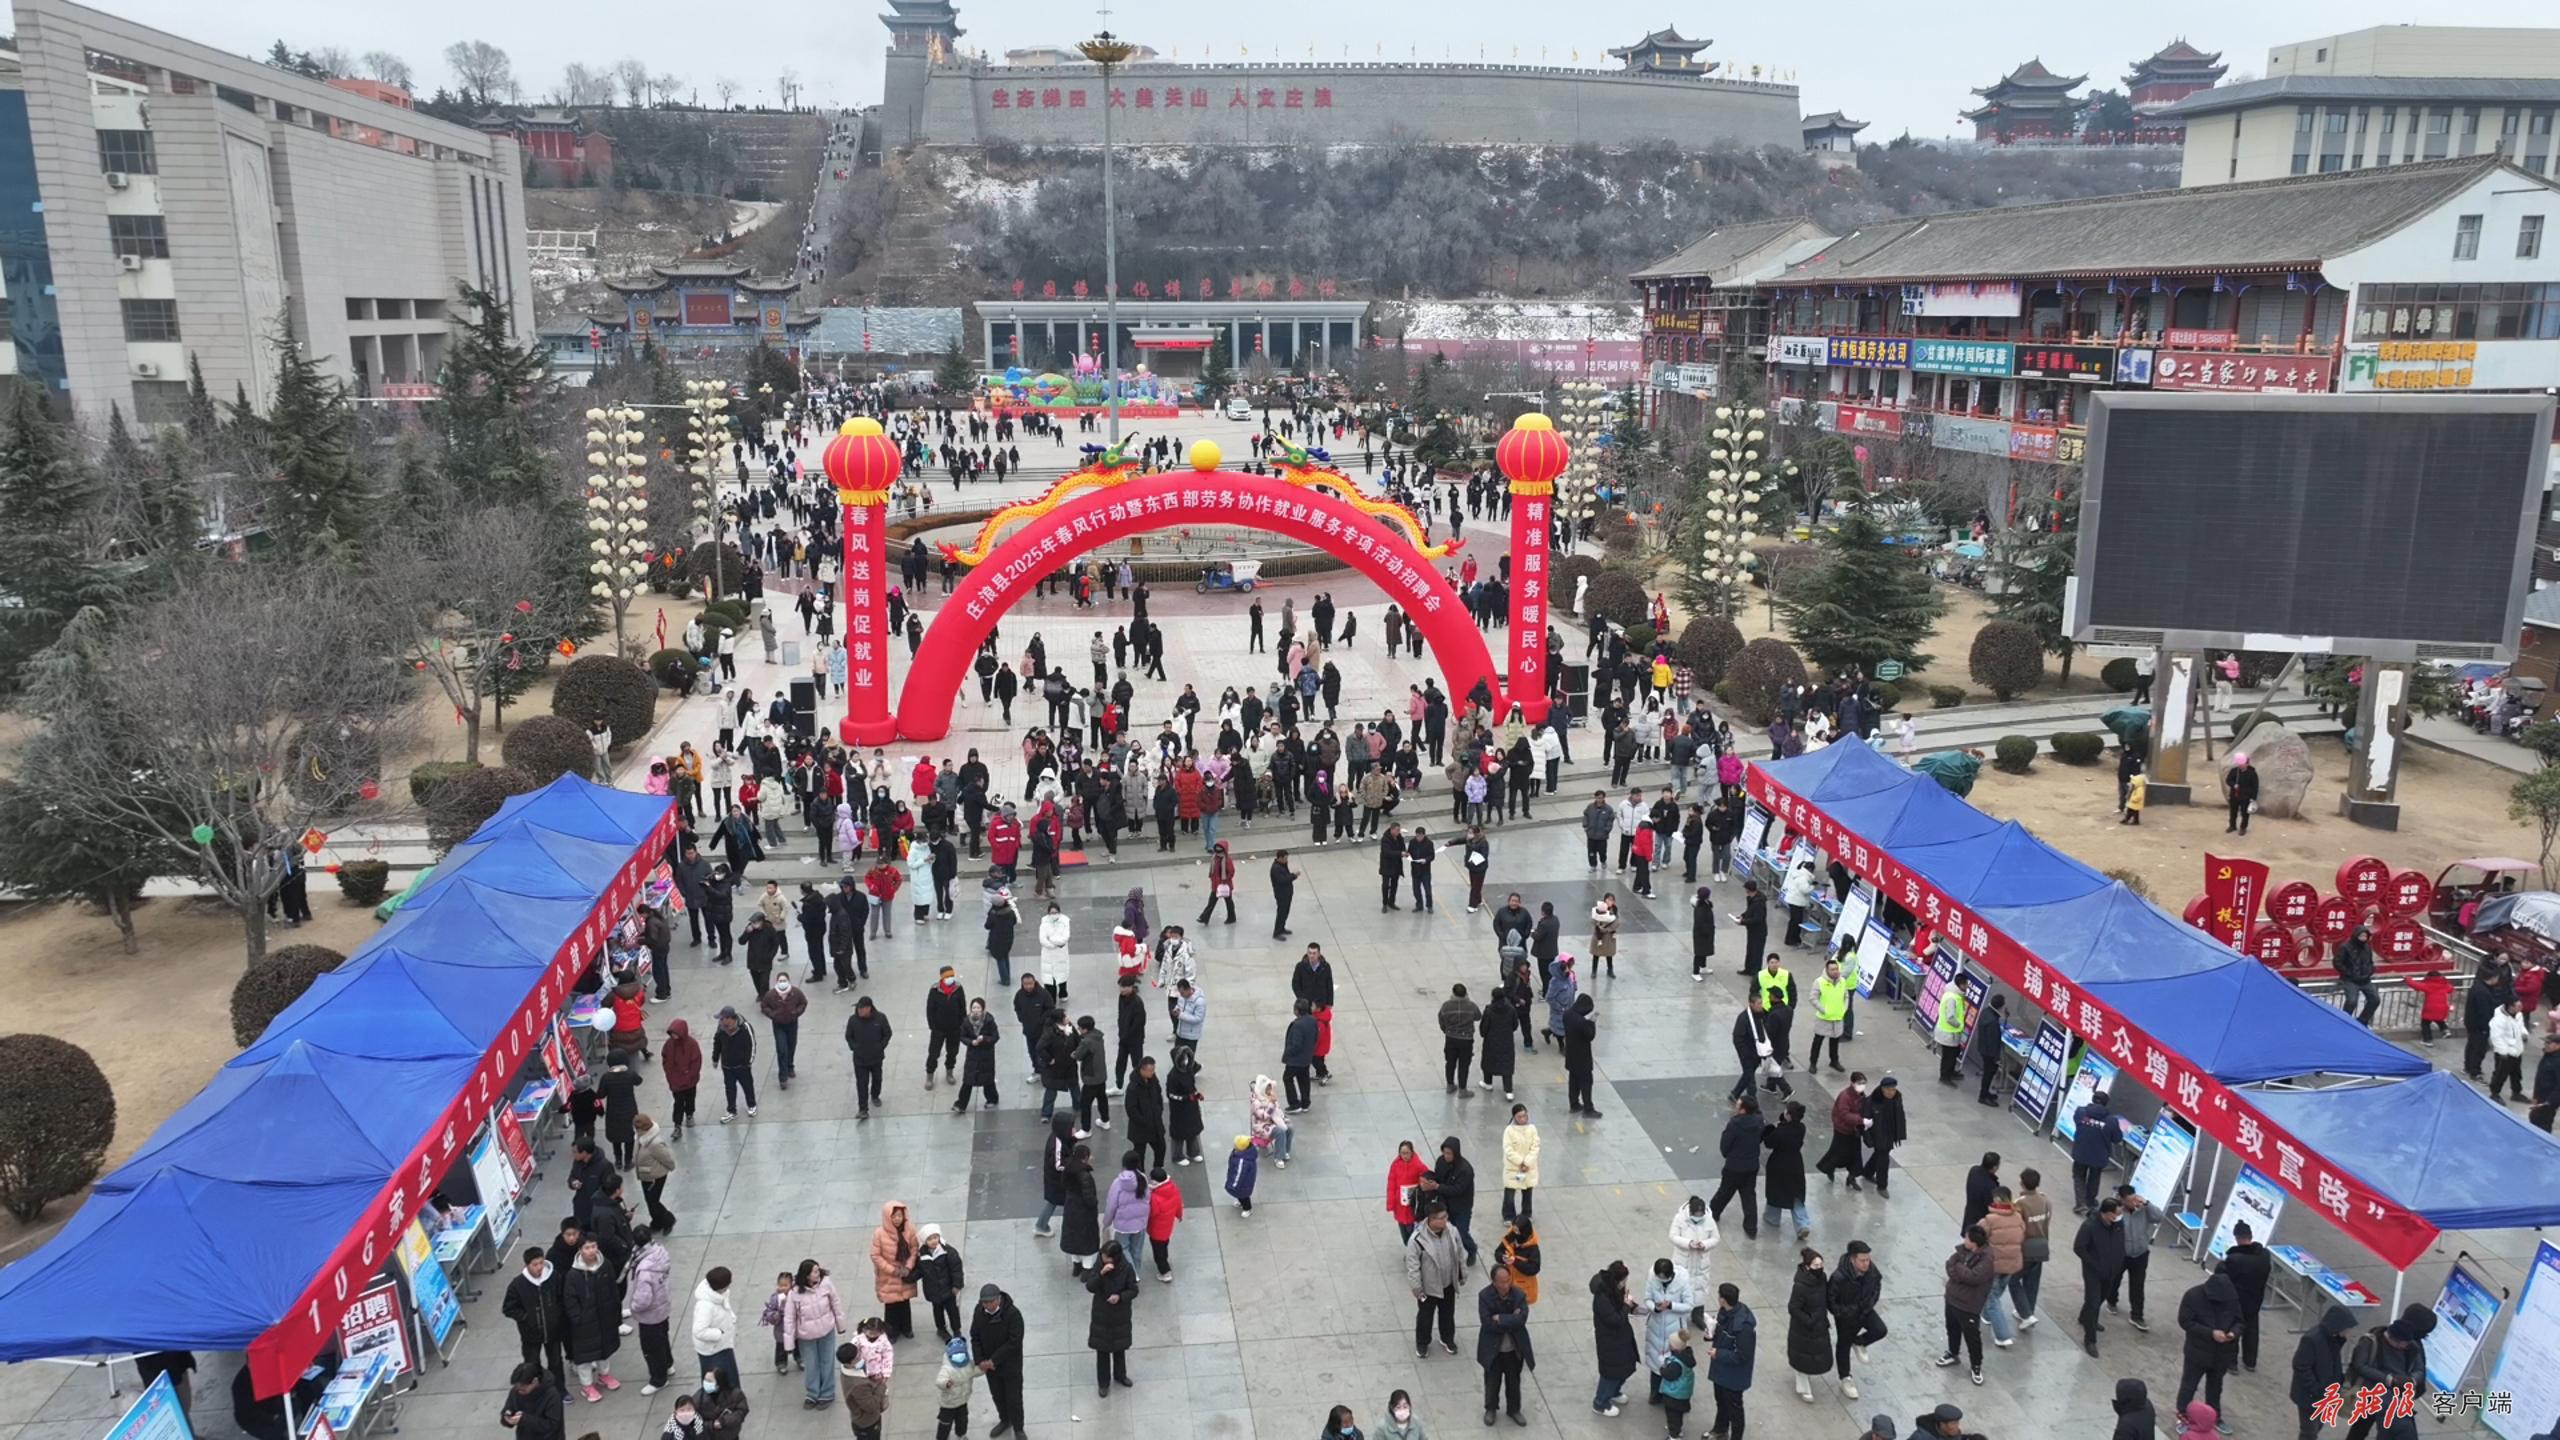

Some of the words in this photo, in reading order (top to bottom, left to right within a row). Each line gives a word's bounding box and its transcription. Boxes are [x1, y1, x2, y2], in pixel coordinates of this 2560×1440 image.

[992, 88, 1087, 108] 生态梯田
[1110, 87, 1208, 108] 大美关山
[1229, 87, 1332, 108] 人文庄浪
[1831, 340, 1907, 362] 甘肃恒通劳务公司
[2350, 355, 2376, 381] F1
[966, 489, 1441, 621] 庄浪县2025年春风行动暨东西部劳务协作就业服务专项活动招聘会
[850, 507, 873, 689] 春风送岗促就业
[1519, 502, 1544, 674] 精准服务暖民心
[2359, 871, 2377, 881] 公正
[2237, 876, 2248, 916] 社会主义
[2358, 883, 2376, 892] 法治
[2286, 907, 2304, 916] 和谐
[2288, 896, 2306, 905] 文明
[2216, 907, 2242, 929] 核心
[2328, 911, 2345, 919] 自由
[2261, 950, 2279, 958] 民主
[342, 1294, 389, 1330] 招聘
